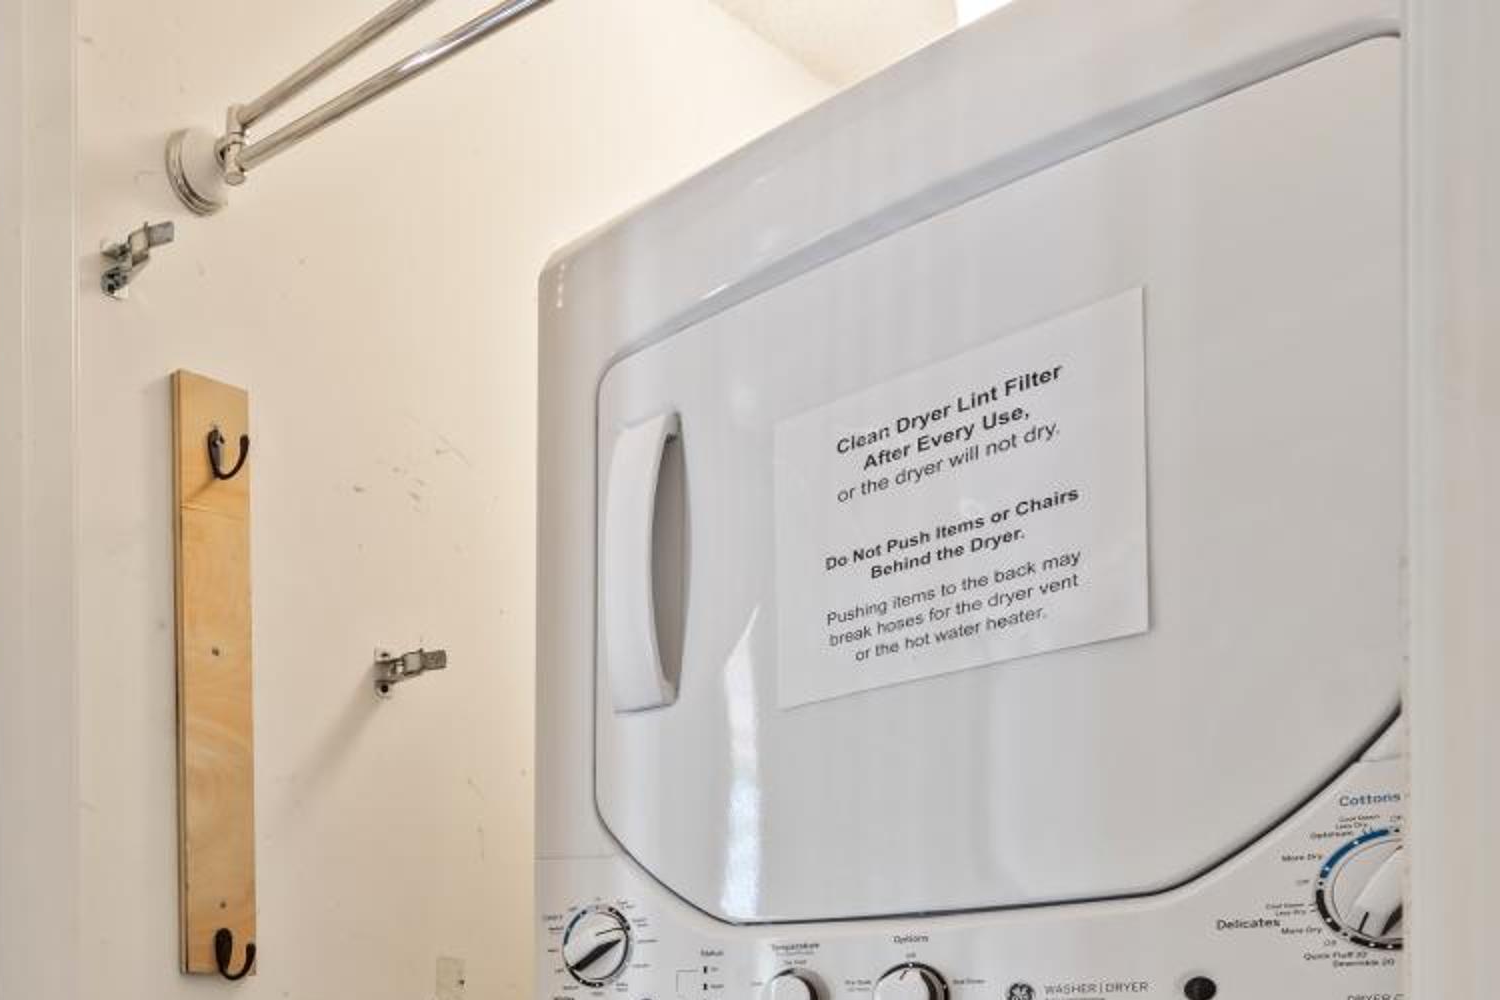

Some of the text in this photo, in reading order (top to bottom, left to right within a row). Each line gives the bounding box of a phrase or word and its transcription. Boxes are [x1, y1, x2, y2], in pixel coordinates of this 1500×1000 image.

[837, 365, 1062, 455] Clean Dryer Lint Filter
[863, 408, 1029, 470] After Every Use,
[837, 422, 1060, 502] or the dryer will not dry.
[825, 488, 1079, 571] Do Not Push Items or Chairs
[871, 528, 1025, 579] Behind the Dryer.
[827, 551, 1081, 626] Pushing items to the back may
[829, 574, 1079, 647] break hoses for the dryer vent
[855, 605, 1047, 662] or the hot water heater.
[1340, 794, 1401, 806] Cottons
[1216, 918, 1280, 931] Delicates
[1106, 982, 1148, 993] DRYER
